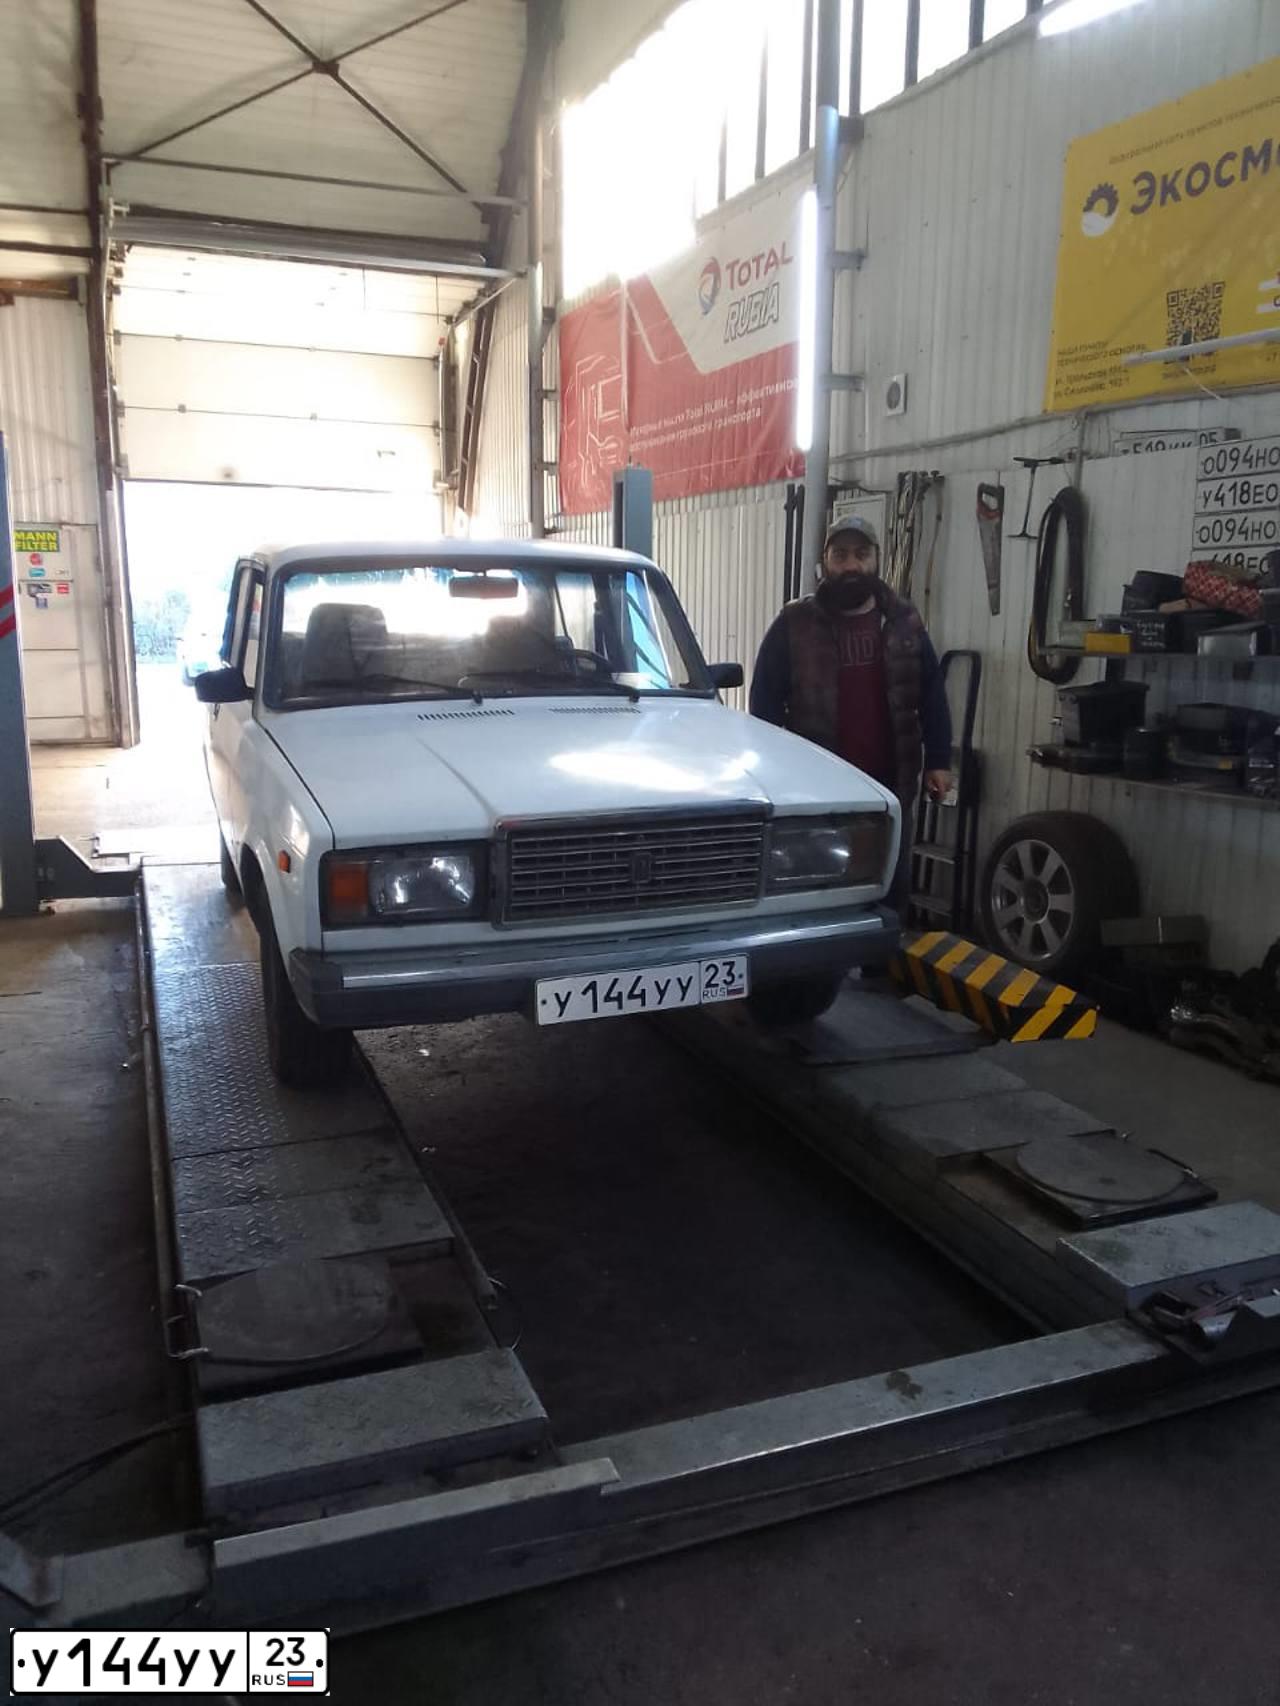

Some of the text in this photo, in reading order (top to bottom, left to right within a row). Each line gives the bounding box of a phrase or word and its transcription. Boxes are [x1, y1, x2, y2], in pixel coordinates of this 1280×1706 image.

[725, 242, 793, 290] TOTAL
[724, 282, 779, 343] RUBIA
[15, 532, 56, 541] MANN
[704, 960, 736, 988] 23
[702, 987, 726, 999] RUS
